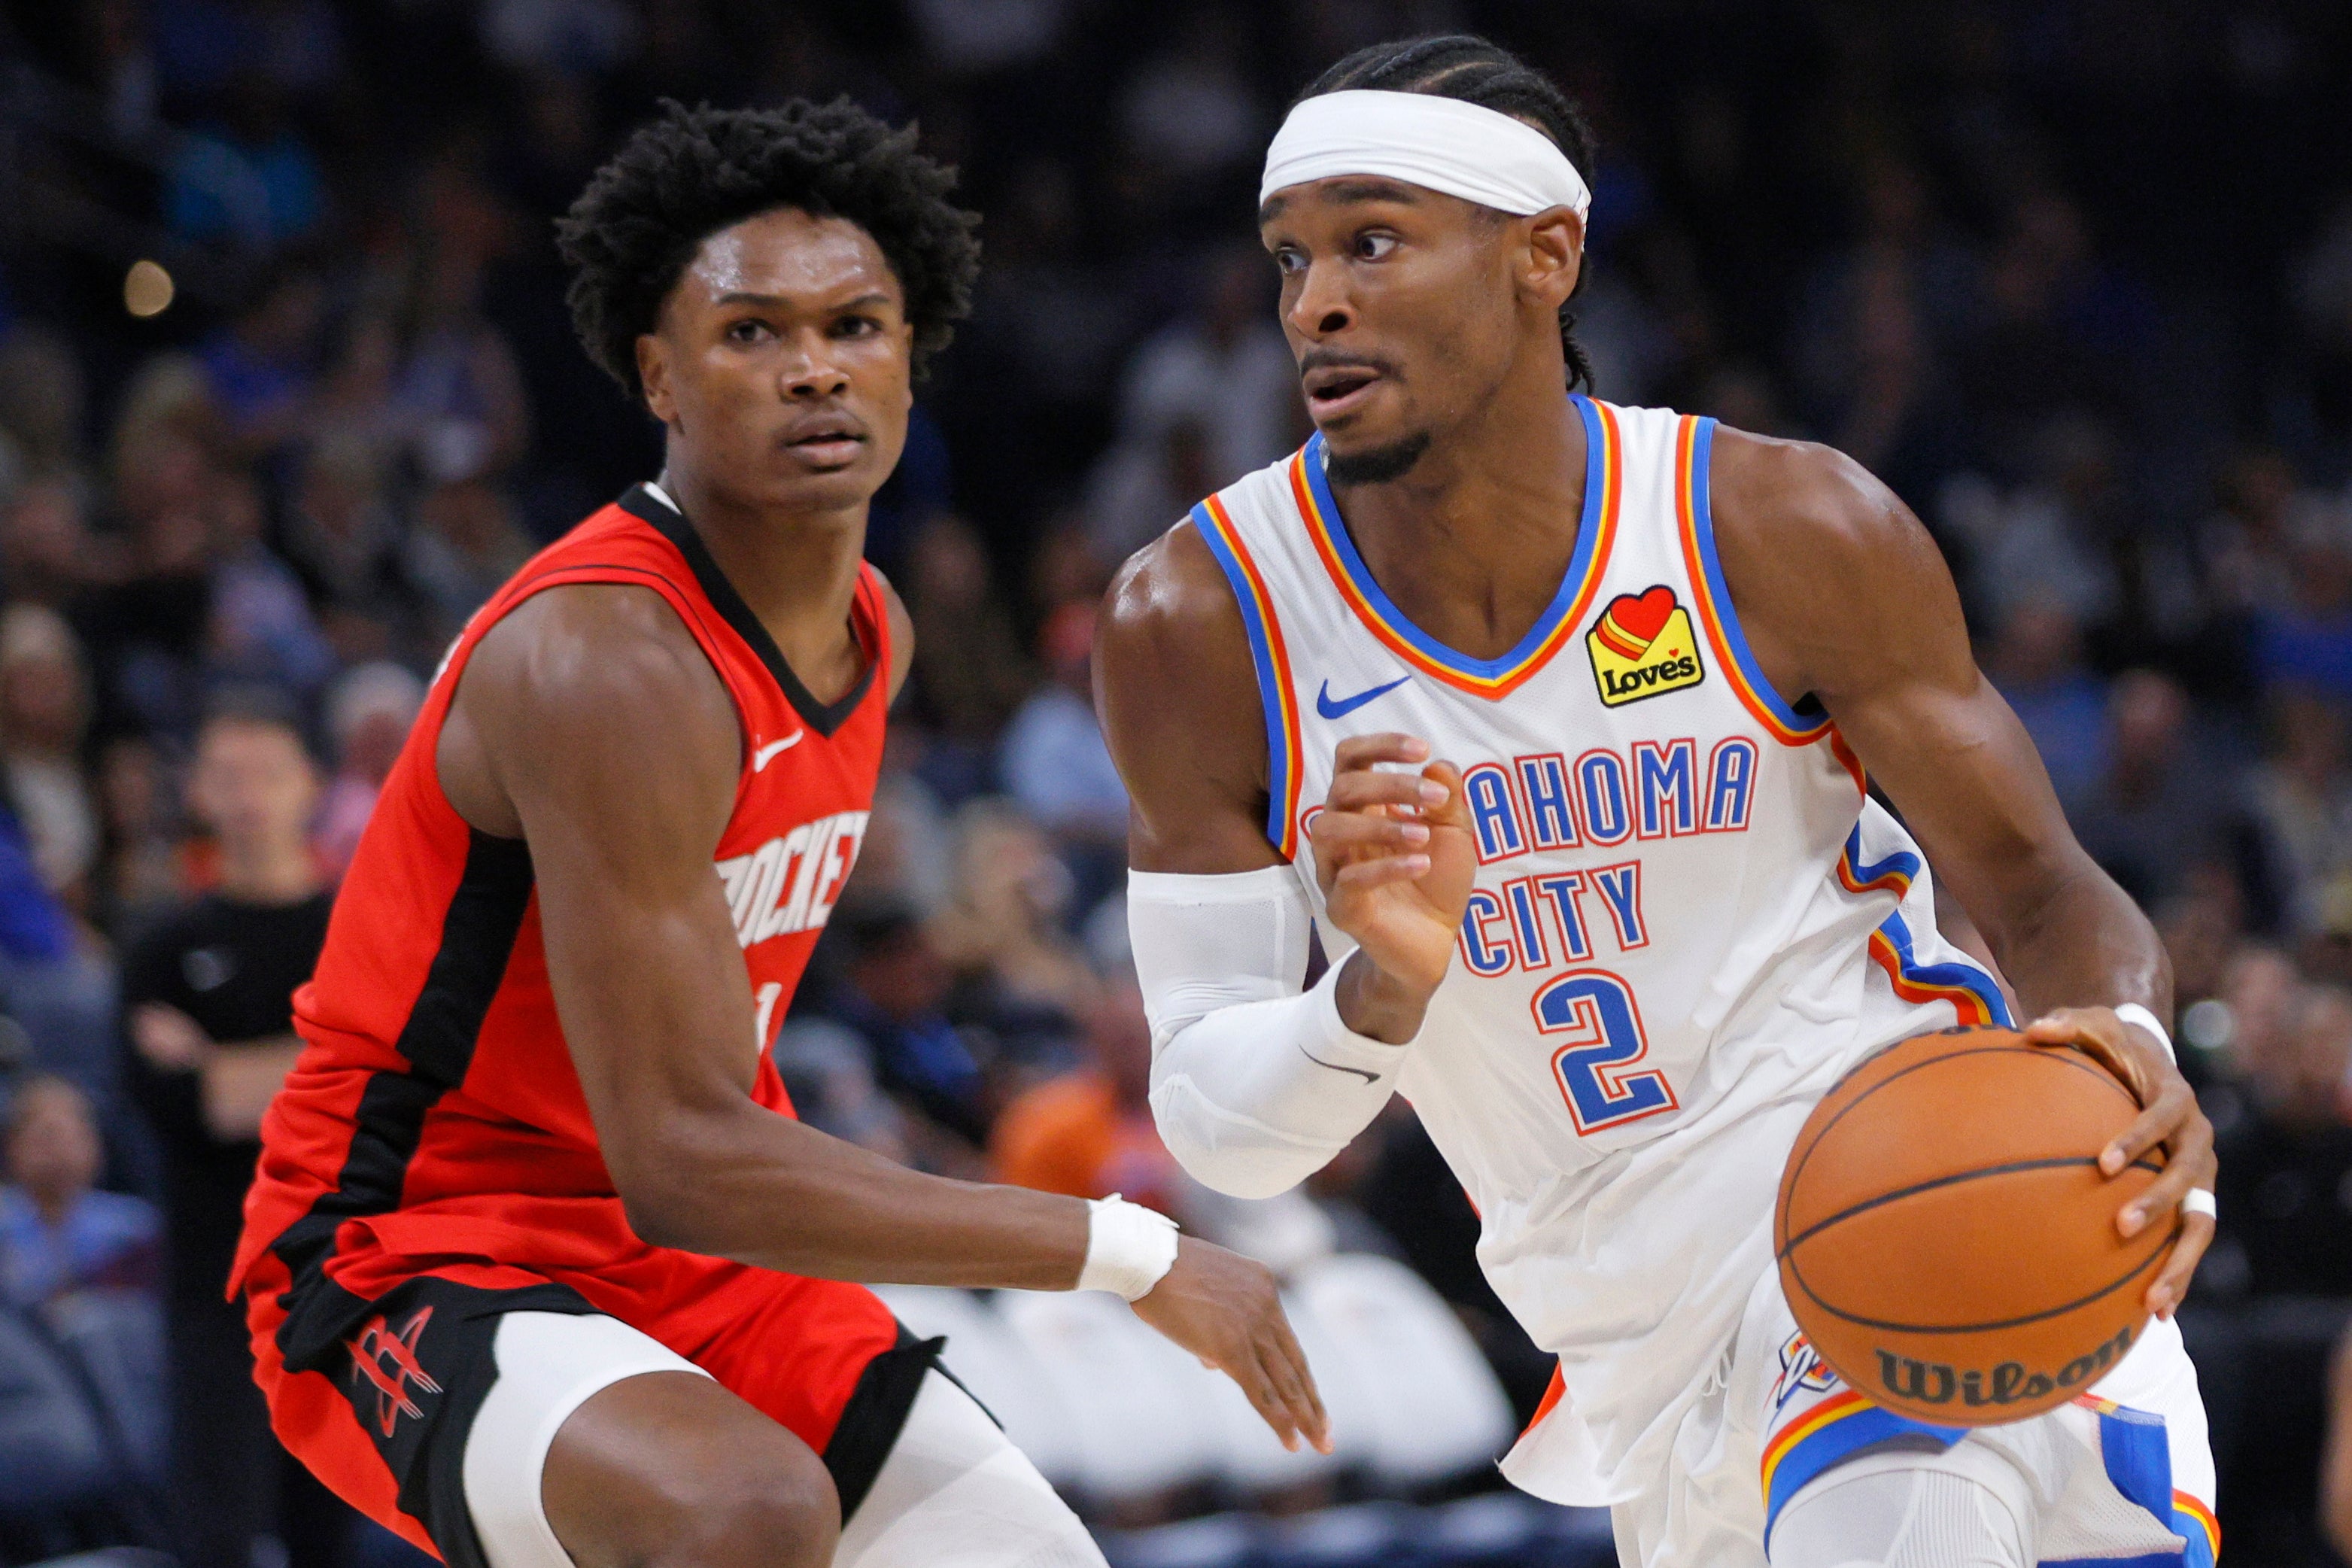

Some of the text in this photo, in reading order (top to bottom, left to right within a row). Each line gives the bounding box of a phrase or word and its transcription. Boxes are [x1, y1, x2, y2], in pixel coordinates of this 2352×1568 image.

[1300, 737, 1759, 866] AHOMA
[1457, 860, 1649, 977] CITY
[1530, 968, 1679, 1137] 2
